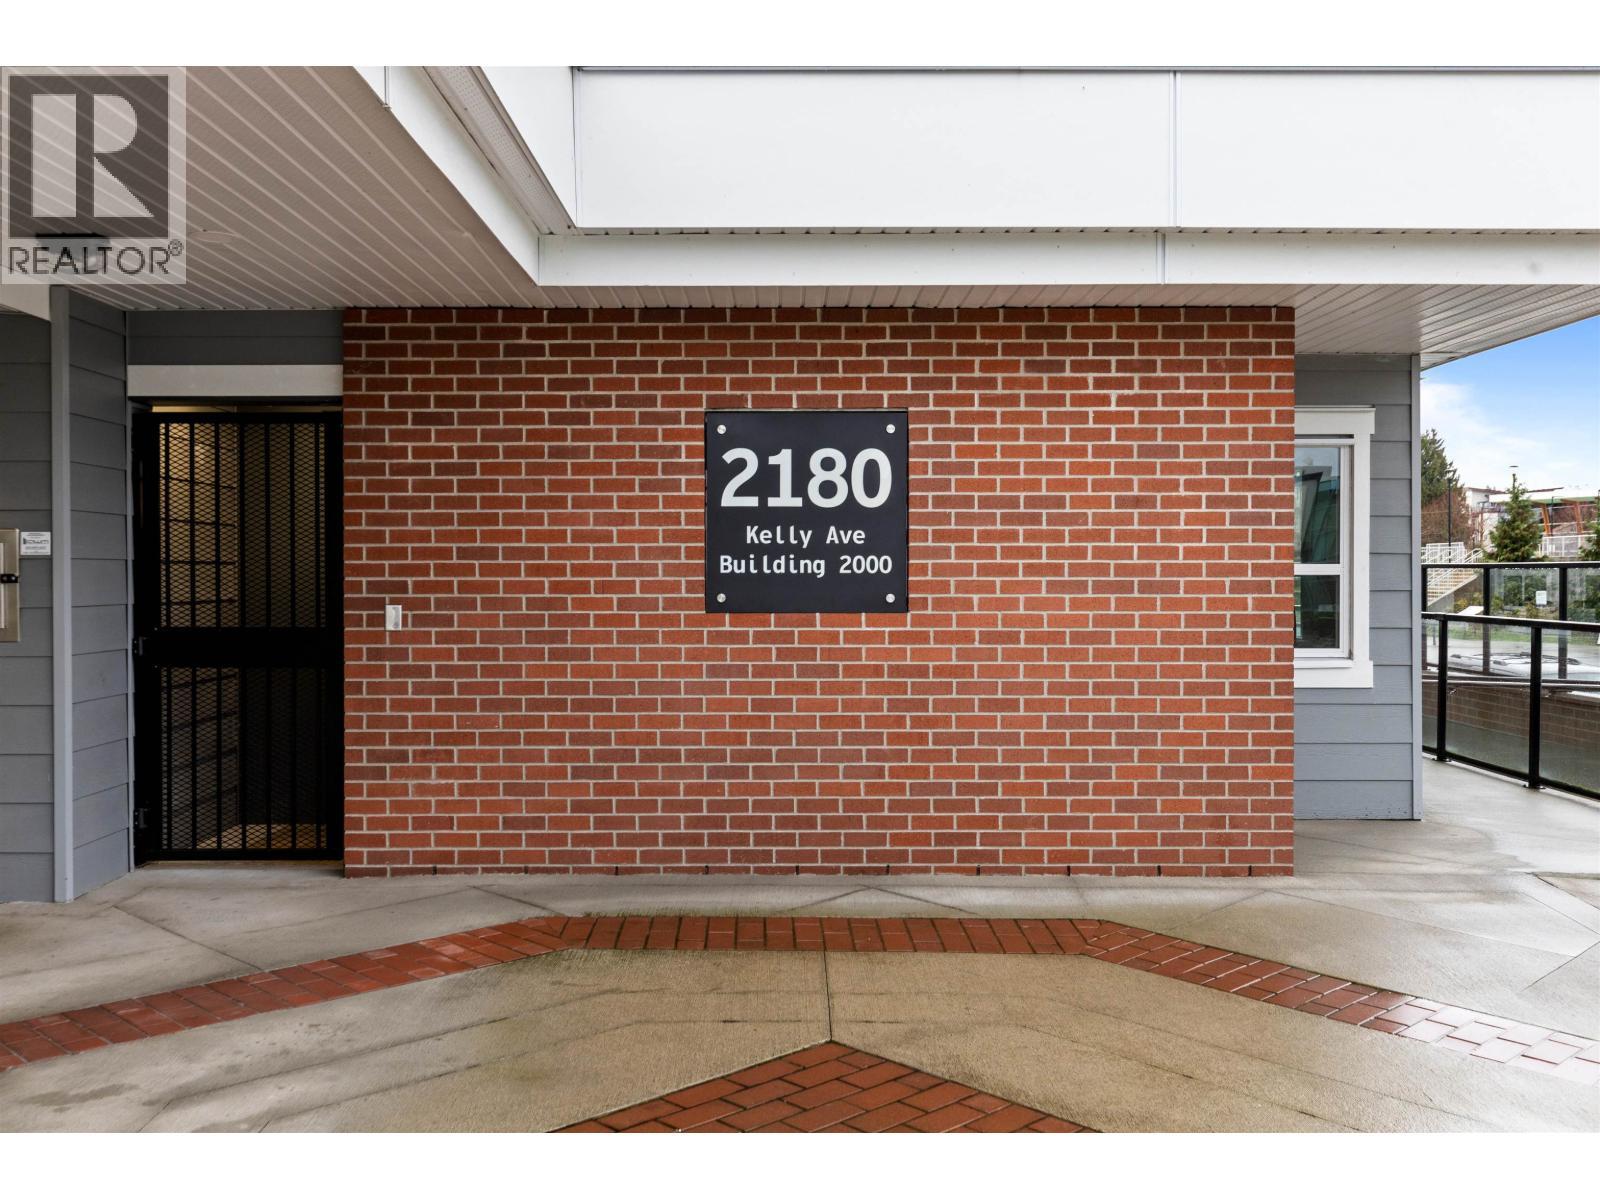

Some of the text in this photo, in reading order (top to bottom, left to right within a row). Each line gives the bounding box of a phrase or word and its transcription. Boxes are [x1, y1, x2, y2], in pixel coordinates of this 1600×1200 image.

[720, 447, 893, 509] 2180
[746, 525, 866, 549] Kelly Ave
[719, 553, 893, 579] Building 2000
